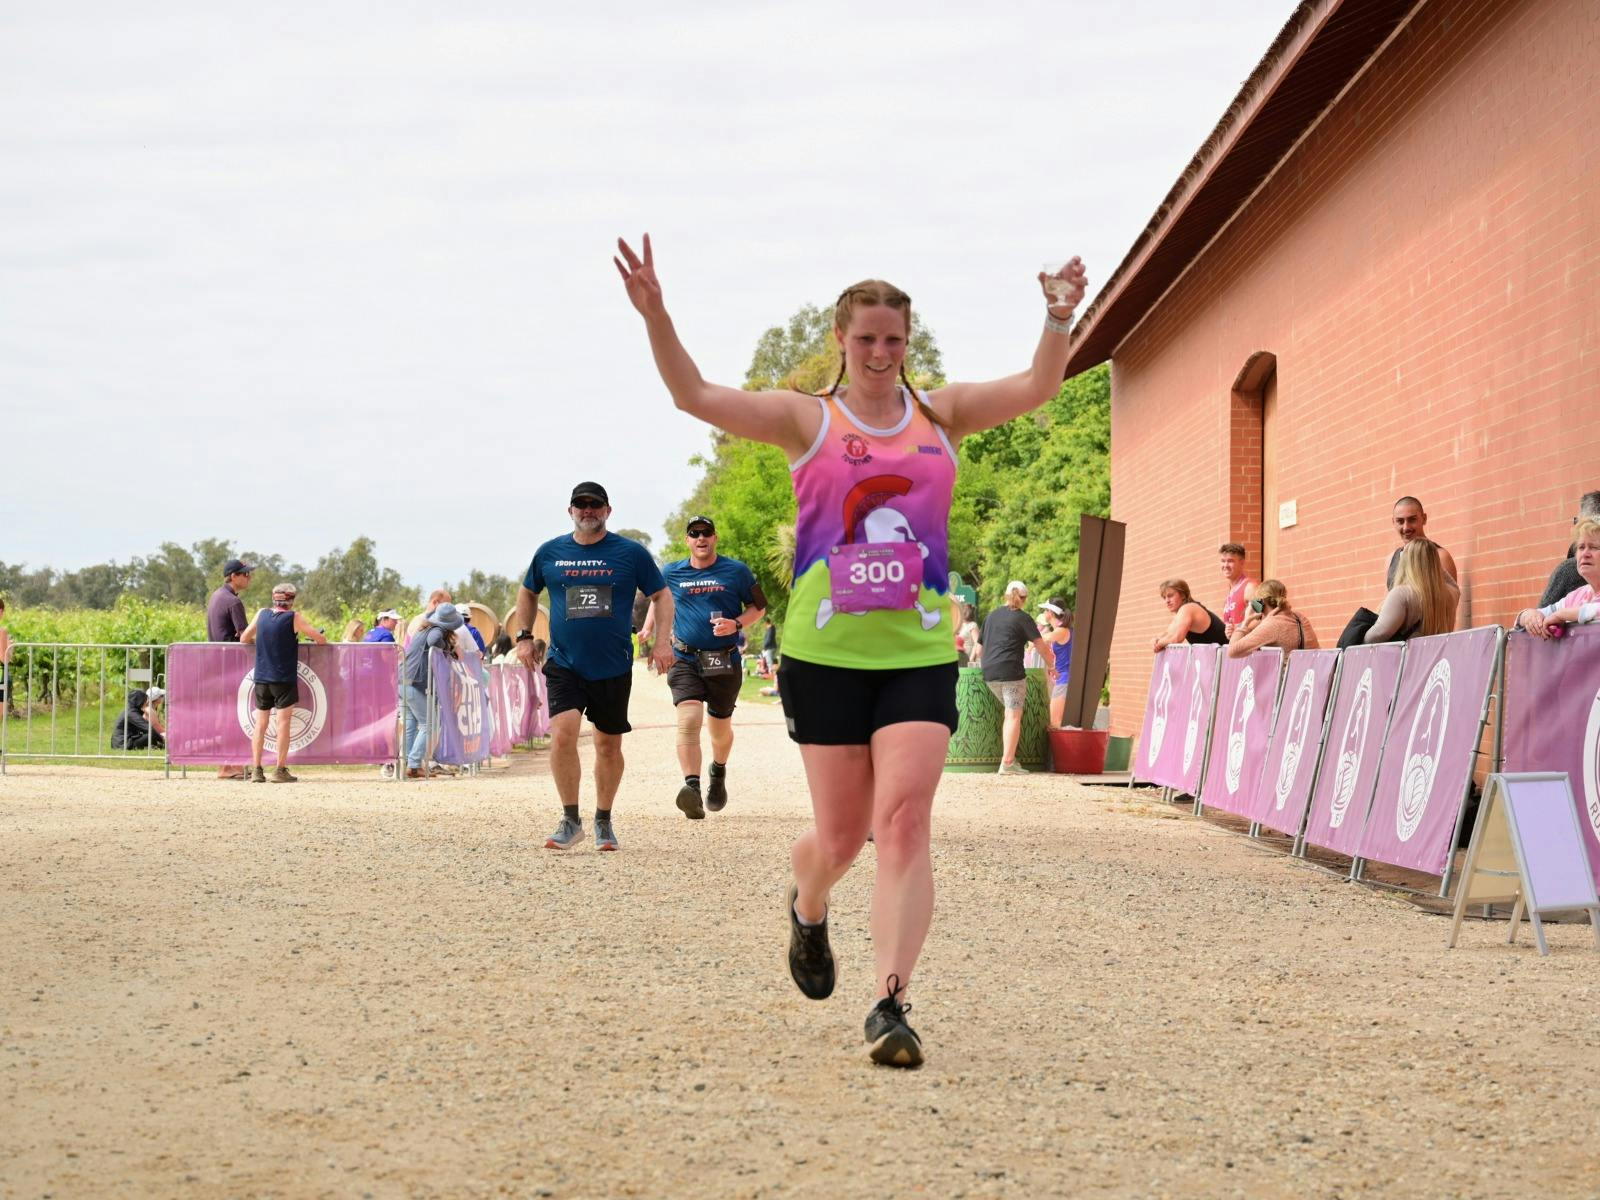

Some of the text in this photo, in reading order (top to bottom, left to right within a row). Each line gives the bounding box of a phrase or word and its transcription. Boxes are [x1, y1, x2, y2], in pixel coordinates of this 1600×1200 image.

[582, 569, 613, 577] FITTY
[849, 560, 905, 585] 300
[580, 594, 597, 605] 72
[708, 657, 721, 666] 76
